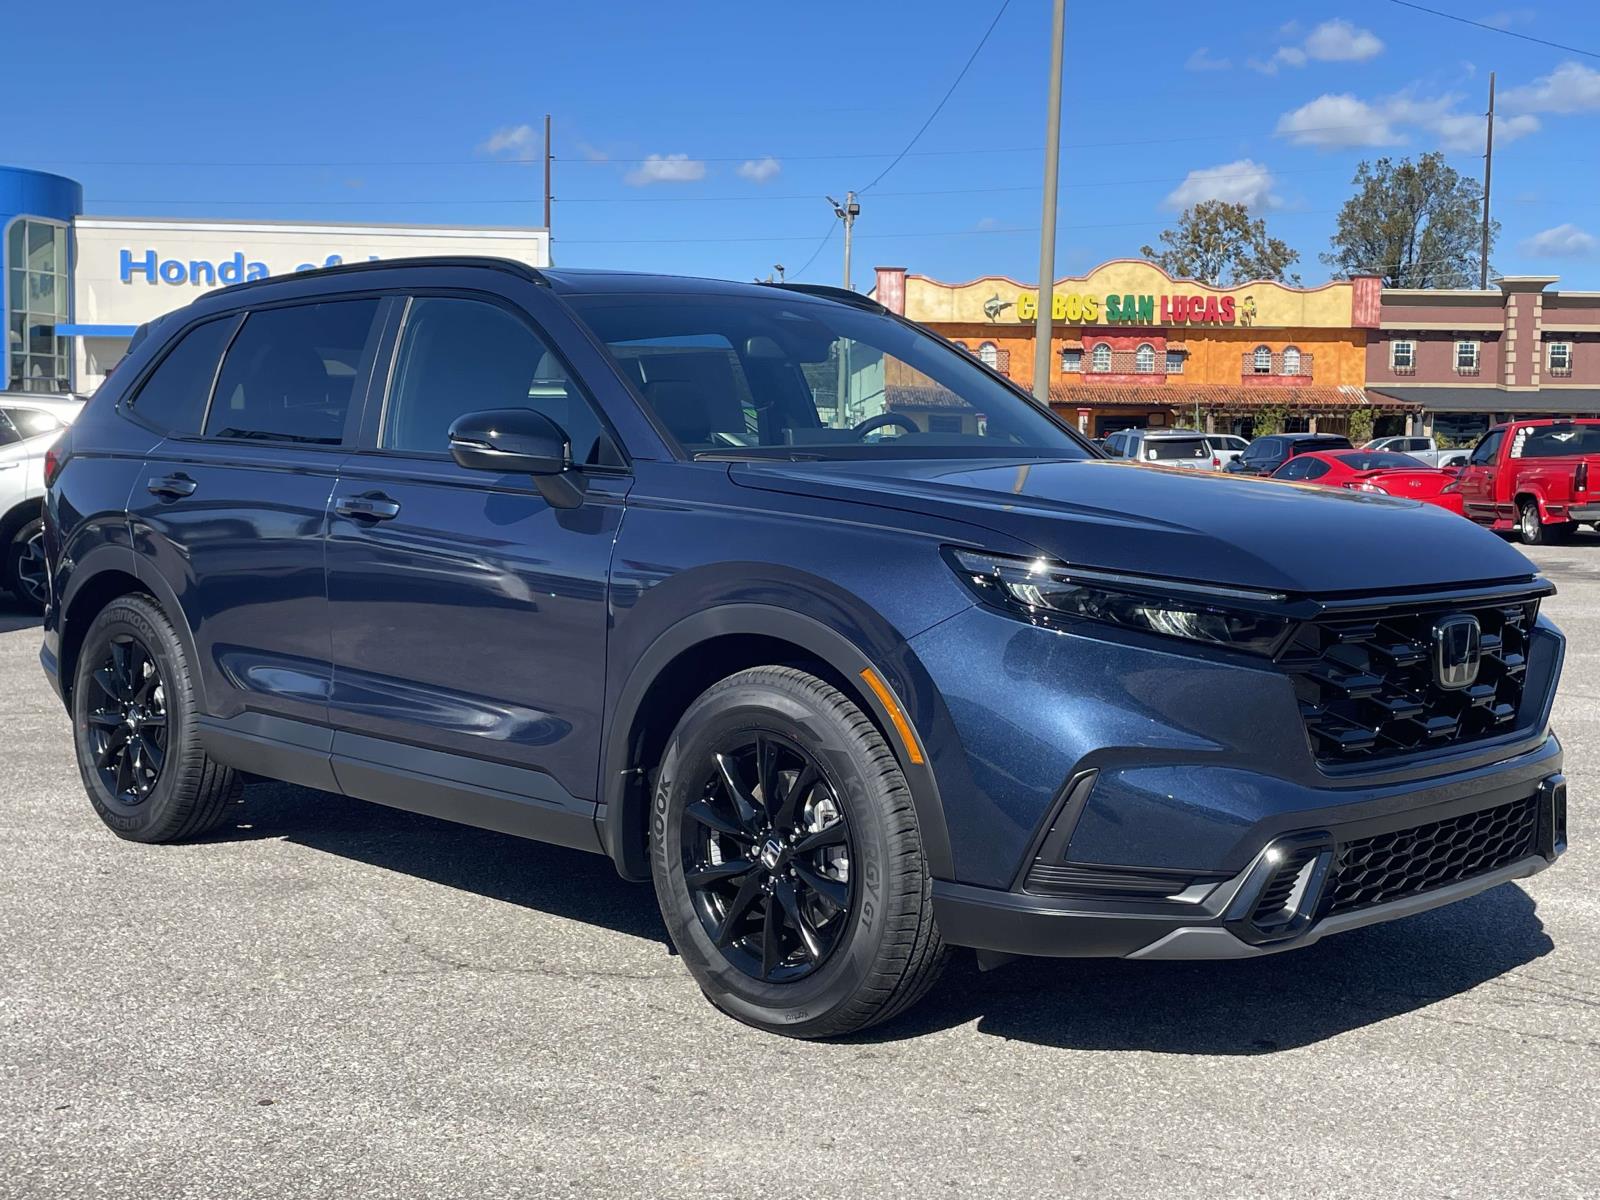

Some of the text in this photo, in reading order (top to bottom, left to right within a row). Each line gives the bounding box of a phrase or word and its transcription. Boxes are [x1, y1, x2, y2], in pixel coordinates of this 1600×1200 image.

[120, 250, 269, 284] Honda
[1106, 295, 1154, 320] SAN
[1160, 296, 1235, 322] LUCAS
